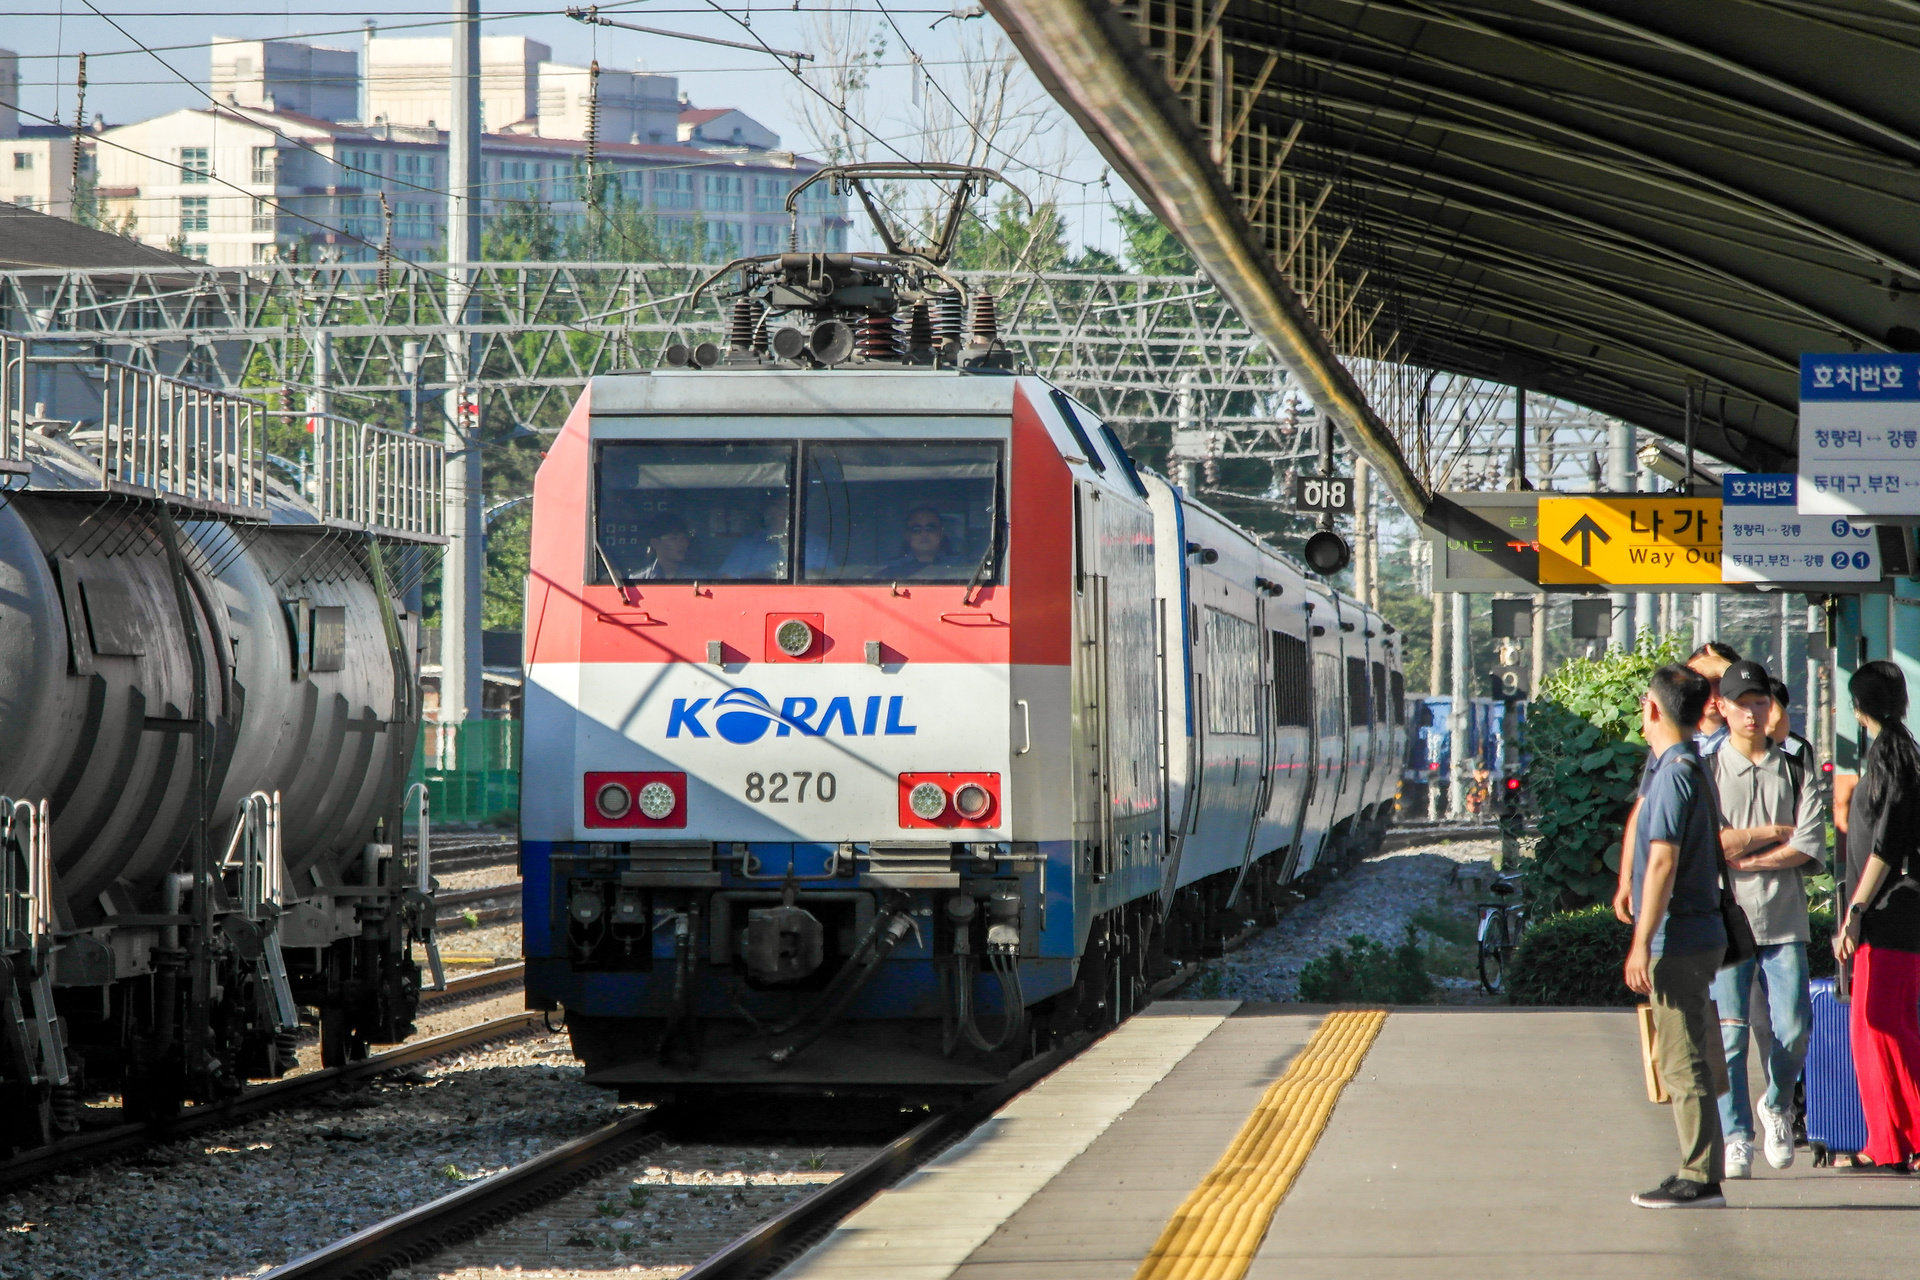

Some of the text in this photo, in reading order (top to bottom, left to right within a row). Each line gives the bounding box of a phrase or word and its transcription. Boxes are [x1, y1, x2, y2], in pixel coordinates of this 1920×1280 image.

[1813, 366, 1904, 392] 호차번호
[1815, 430, 1918, 449] 청량리 강릉
[1304, 481, 1346, 508] 하8
[1732, 481, 1793, 499] 호차번호
[1630, 510, 1723, 542] 나가
[1732, 524, 1765, 537] 청량리
[1780, 524, 1802, 537] 강릉
[1629, 548, 1675, 568] Way
[1804, 554, 1825, 568] 강릉
[1502, 671, 1519, 696] 9
[665, 687, 918, 745] KORAIL
[745, 771, 837, 803] 8270
